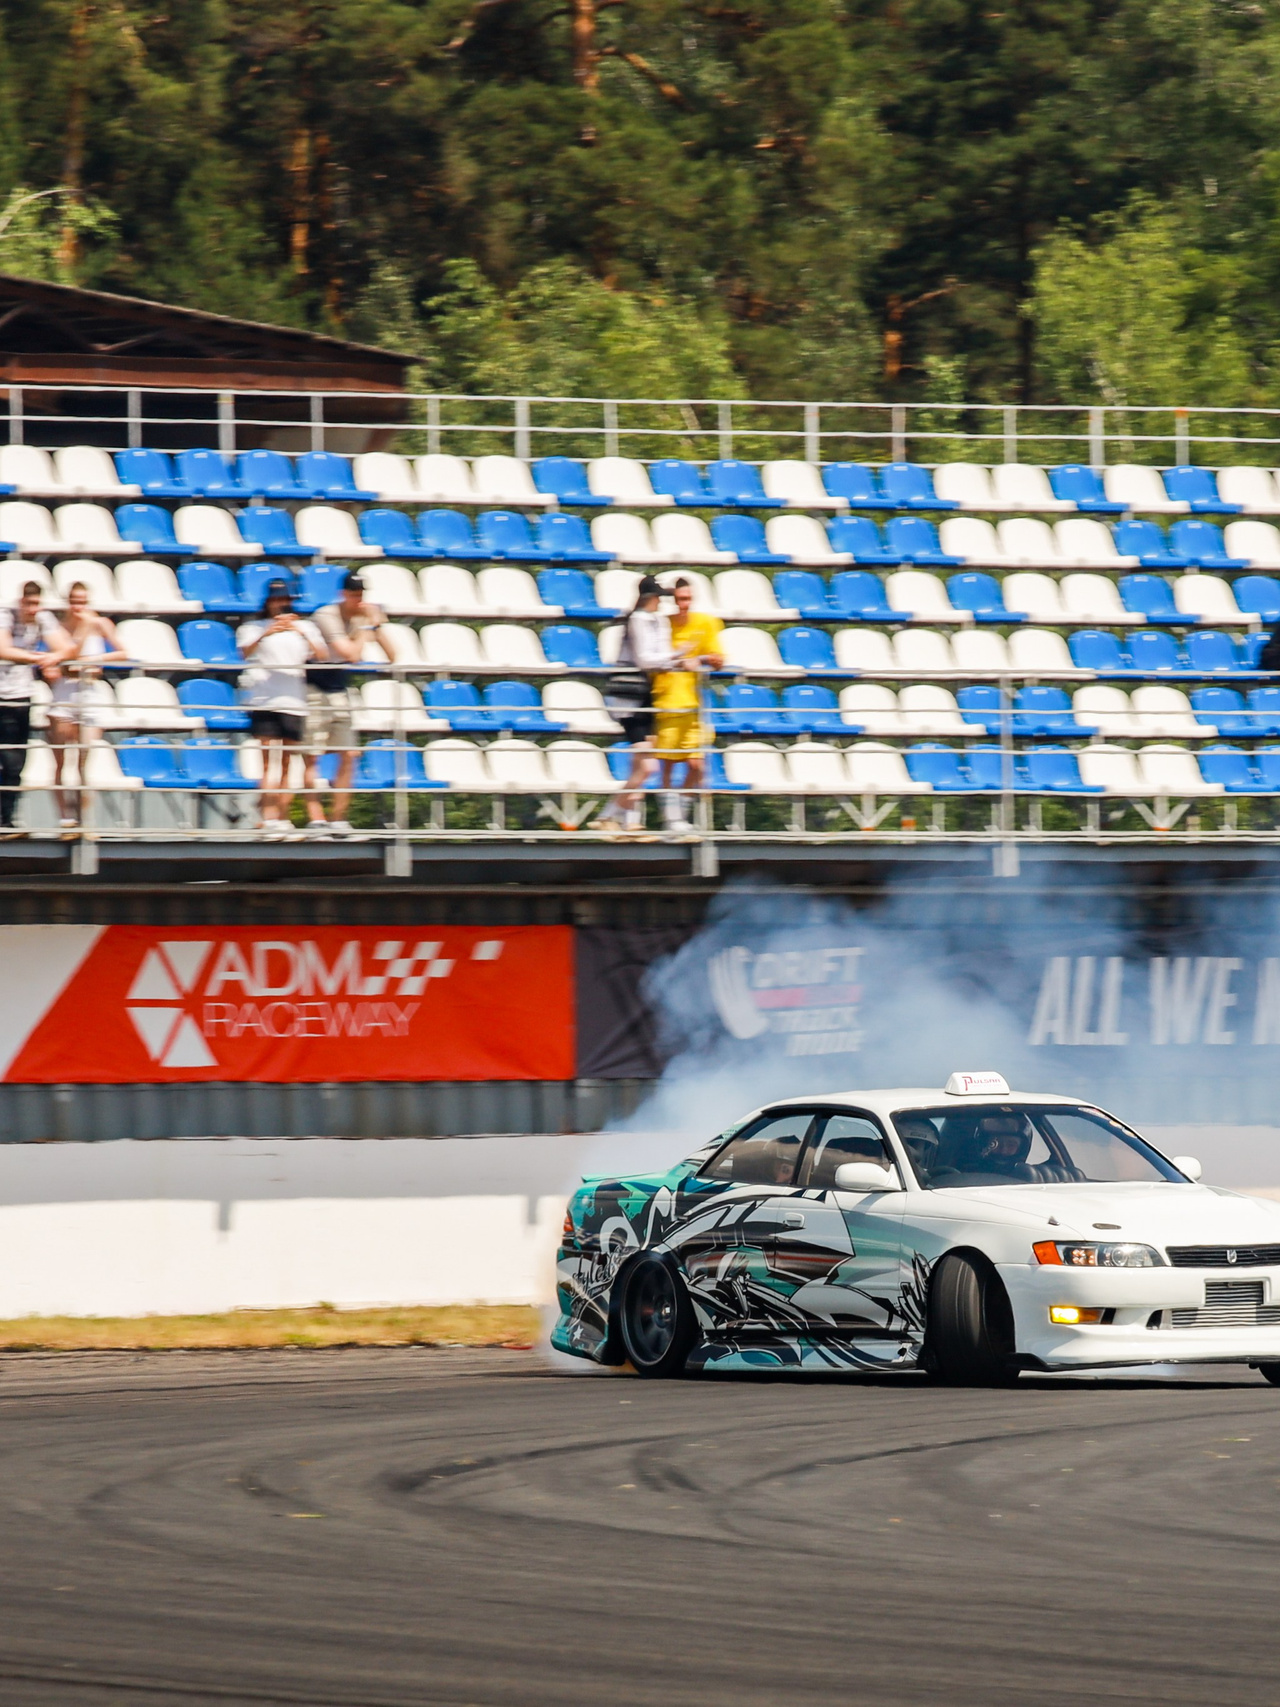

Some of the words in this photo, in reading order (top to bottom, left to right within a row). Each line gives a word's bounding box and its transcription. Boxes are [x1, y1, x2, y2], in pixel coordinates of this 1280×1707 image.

[204, 941, 362, 996] ADM
[203, 1002, 421, 1038] RACEWAY
[1028, 957, 1129, 1046] ALL
[1148, 957, 1243, 1045] WE
